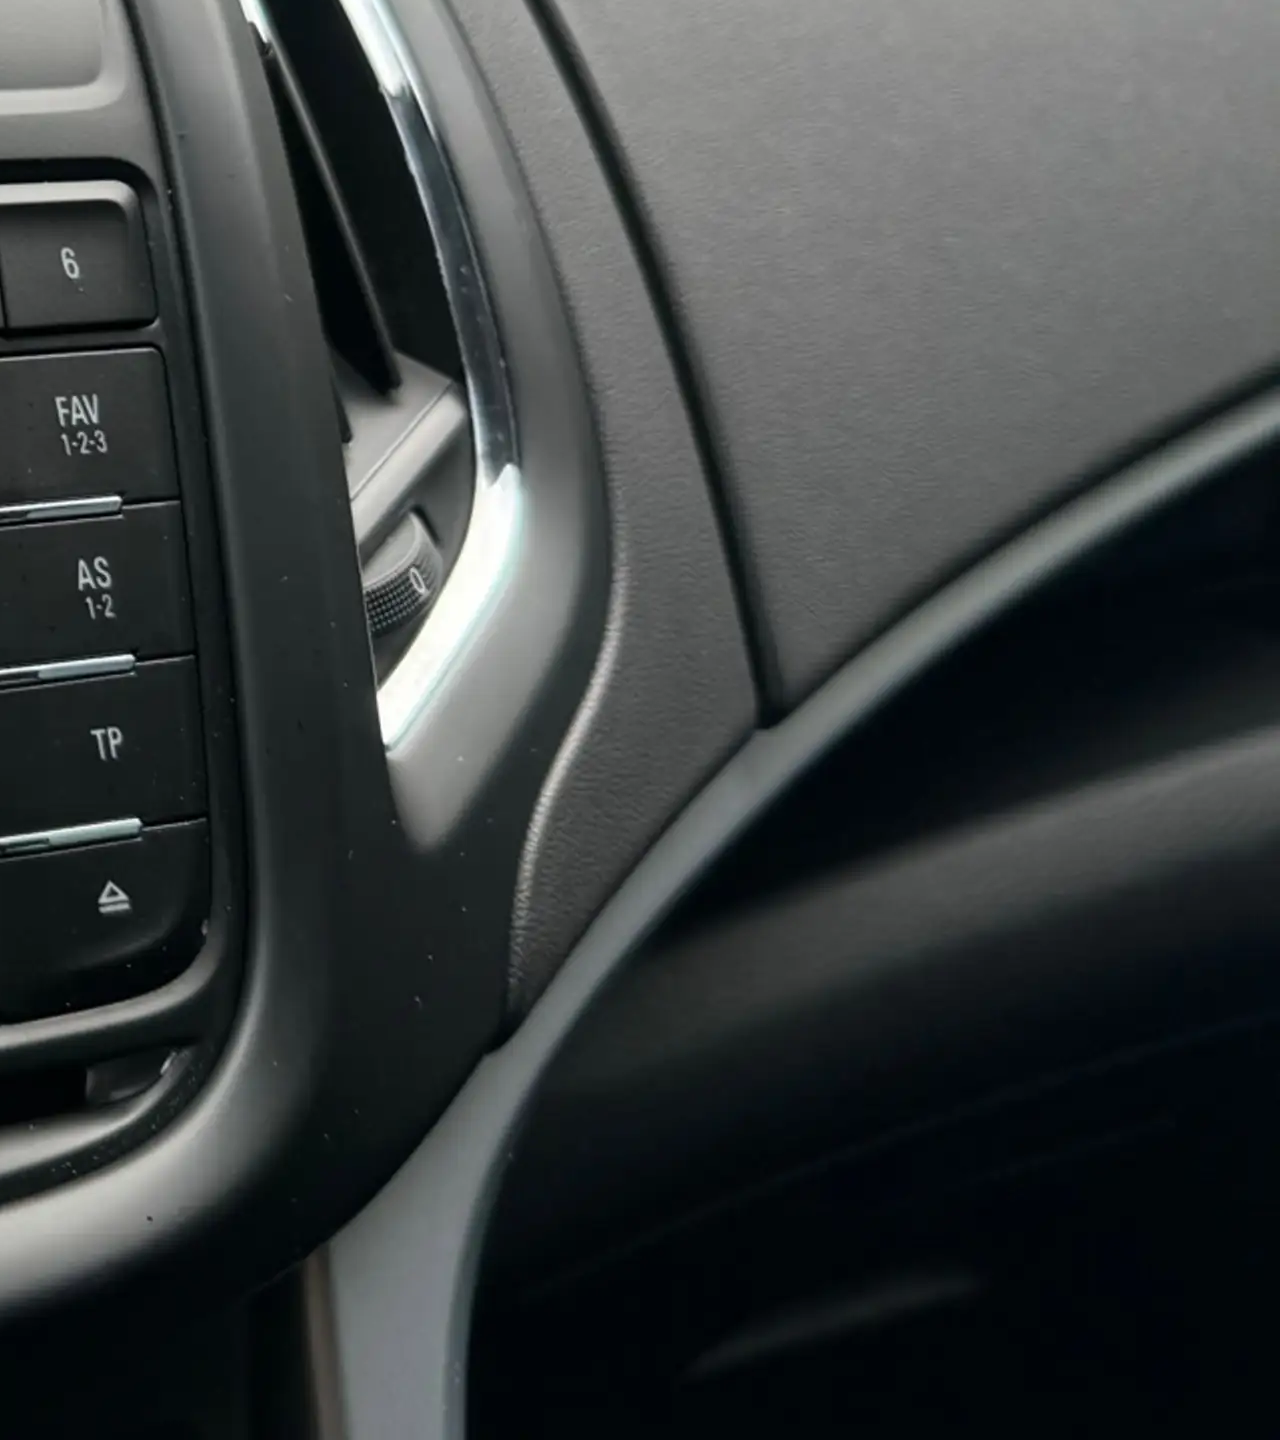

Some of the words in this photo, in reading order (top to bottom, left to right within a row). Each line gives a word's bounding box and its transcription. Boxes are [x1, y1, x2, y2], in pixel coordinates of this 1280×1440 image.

[60, 247, 81, 280] 6
[54, 394, 100, 427] FAV
[60, 430, 109, 457] 1-2-3
[77, 556, 113, 591] AS
[85, 593, 117, 621] 1-2
[90, 725, 125, 761] TP
